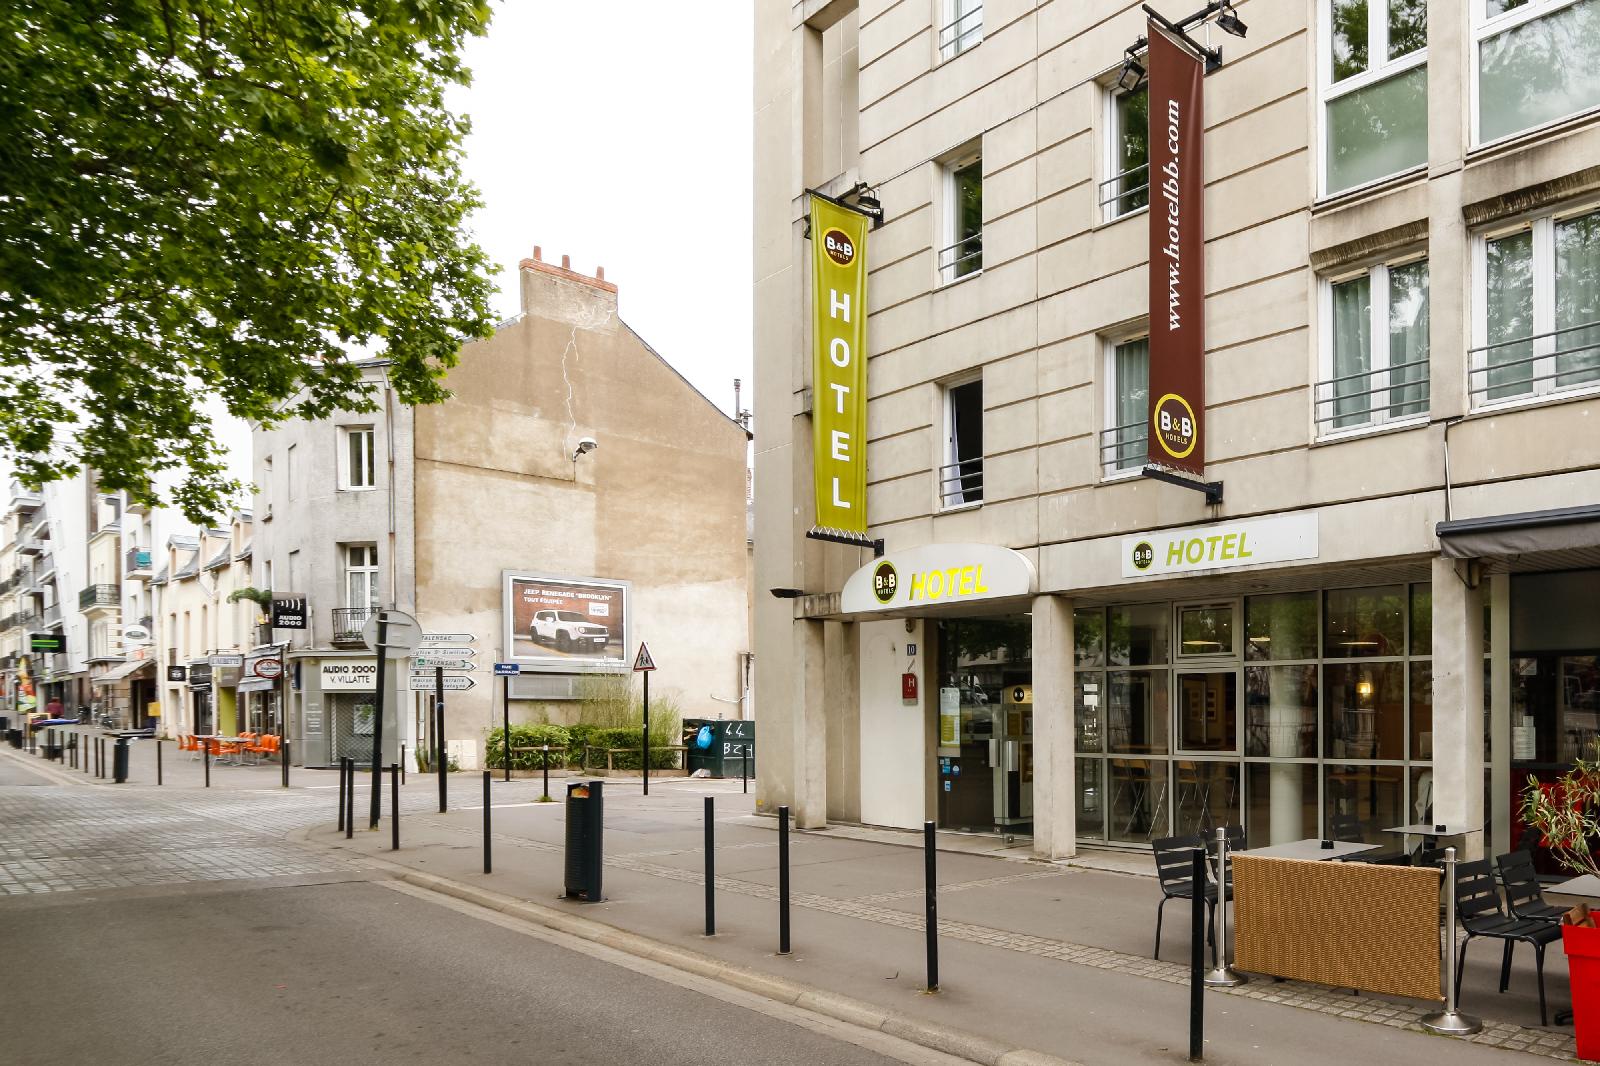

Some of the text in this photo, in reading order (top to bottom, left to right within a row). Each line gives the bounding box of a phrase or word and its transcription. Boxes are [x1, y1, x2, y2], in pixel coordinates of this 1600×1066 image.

[1162, 99, 1181, 331] www.hotelbb.com
[826, 236, 853, 256] B&B
[830, 250, 849, 261] HOTELS
[830, 288, 851, 509] HOTEL
[1161, 410, 1192, 437] B&B
[1165, 432, 1188, 445] HOTELS
[1135, 549, 1152, 561] B&B
[1166, 532, 1253, 567] HOTEL
[875, 573, 896, 590] B&B
[908, 564, 988, 601] HOTEL
[541, 589, 575, 598] RENEGADE
[908, 645, 915, 655] 10
[322, 665, 377, 674] AUDIO 2000
[338, 675, 370, 684] VILLATTE
[908, 678, 915, 687] H
